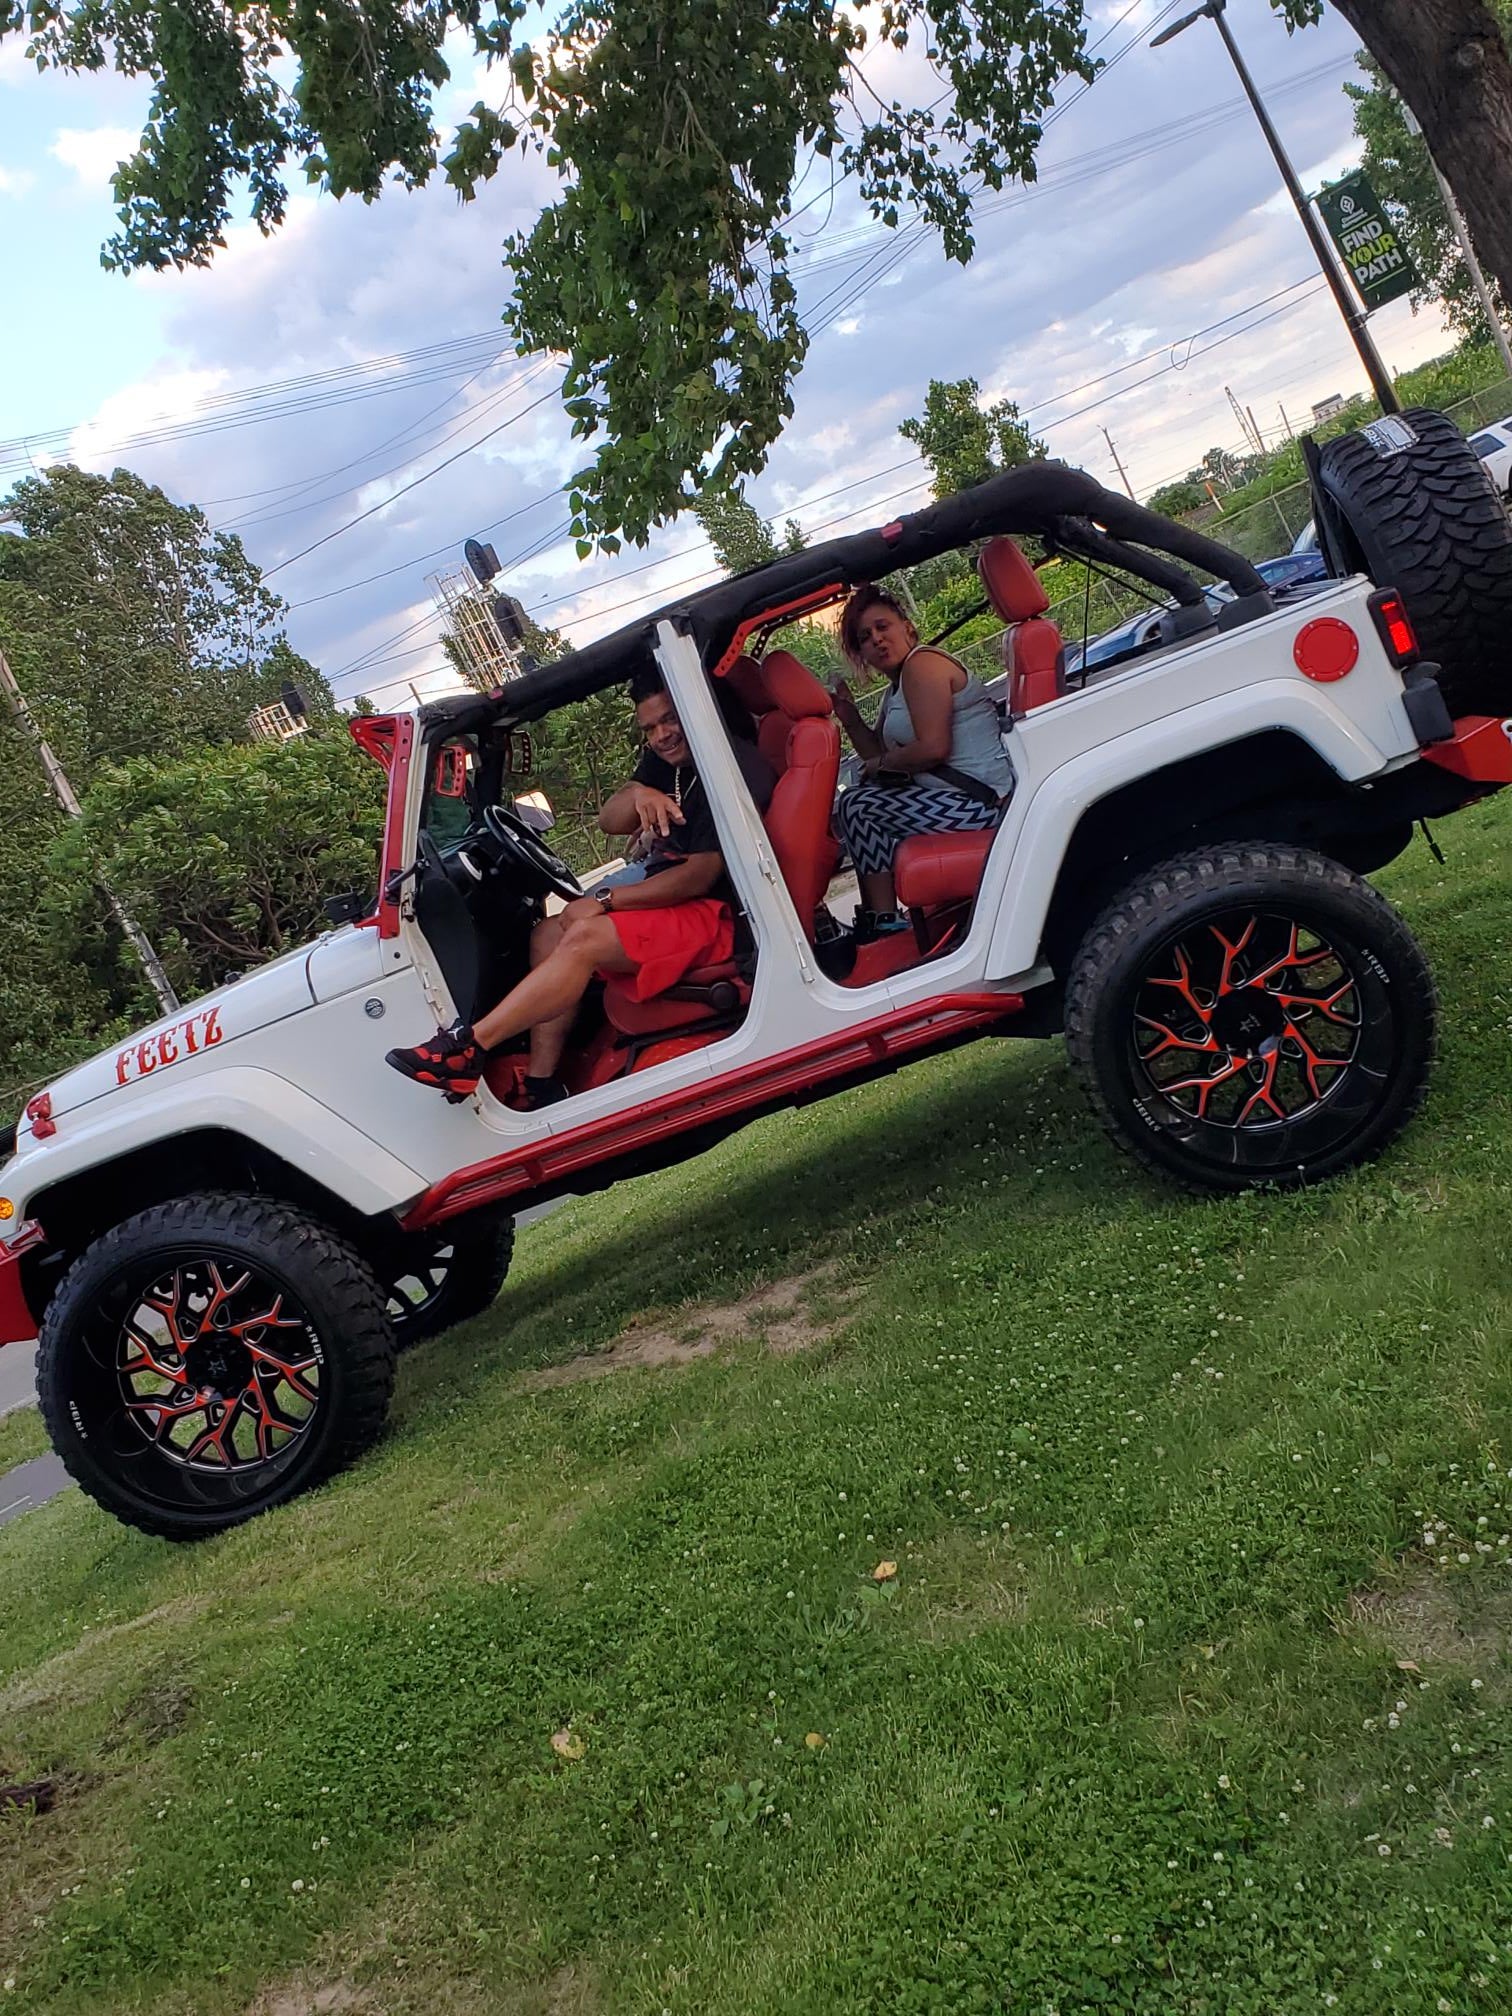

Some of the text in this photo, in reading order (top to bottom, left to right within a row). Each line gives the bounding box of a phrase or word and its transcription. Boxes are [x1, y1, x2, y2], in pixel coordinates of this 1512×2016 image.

[1341, 221, 1383, 253] FIND
[1344, 233, 1398, 268] YOUR
[1354, 248, 1403, 284] PATH
[115, 1004, 223, 1085] FEETZ
